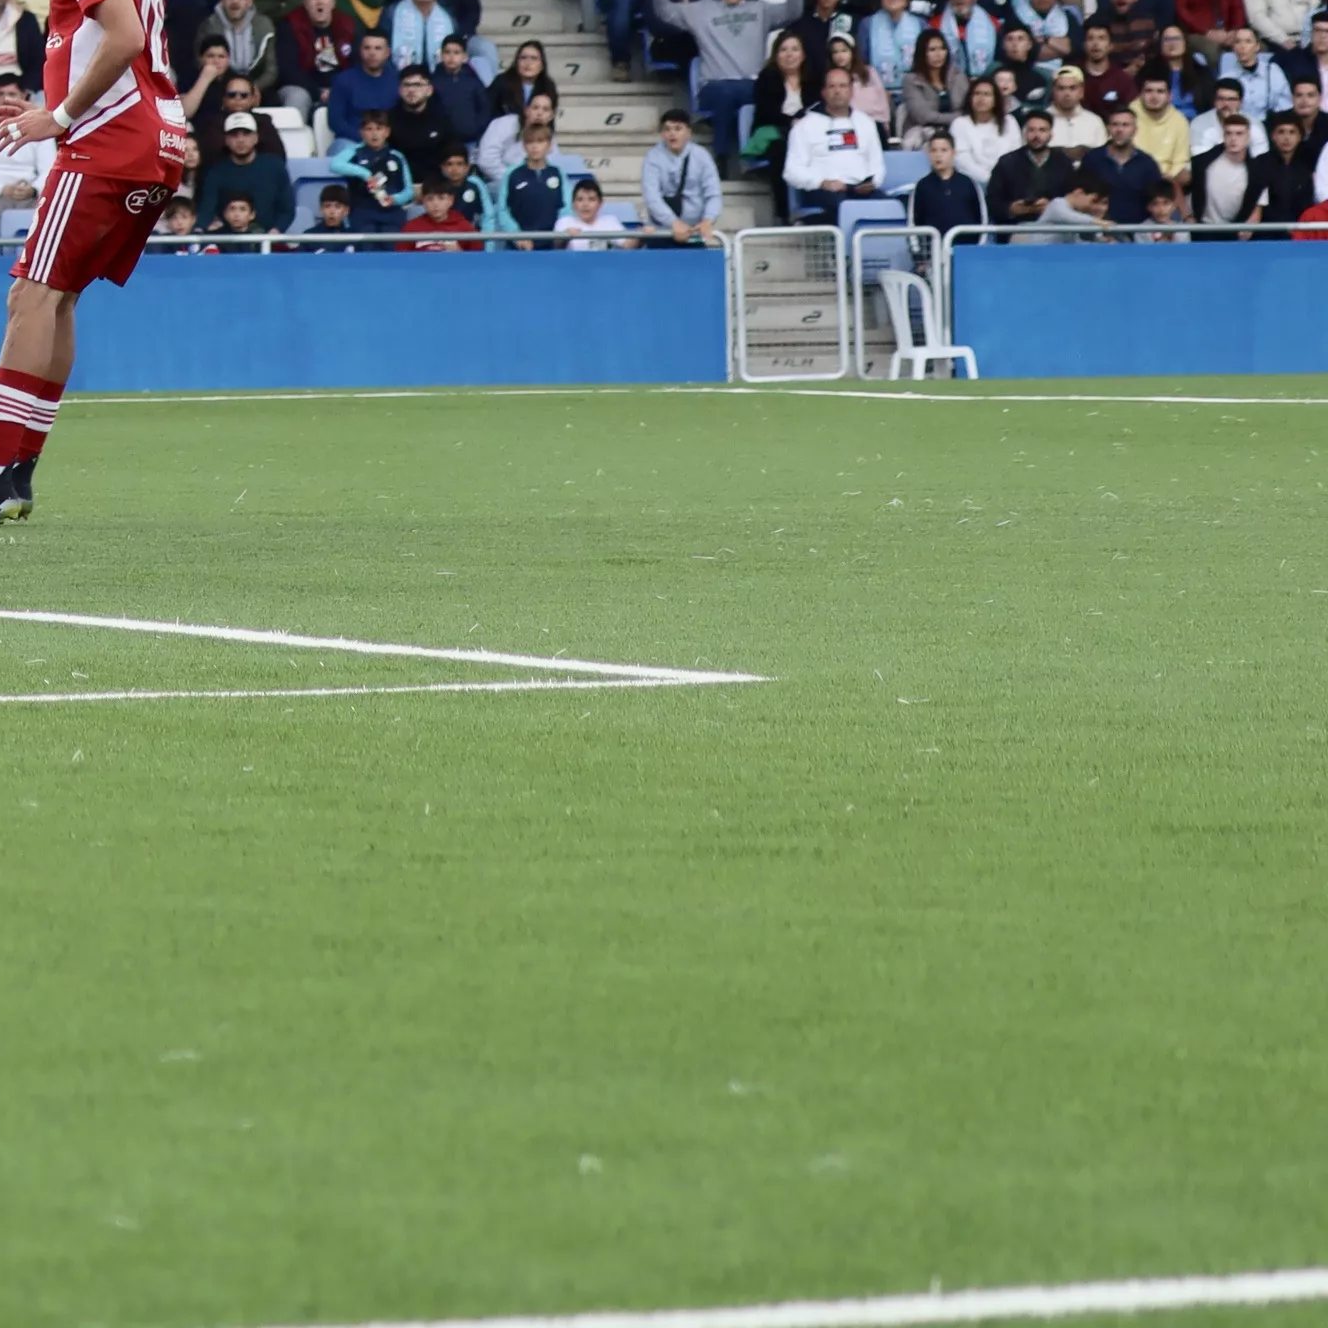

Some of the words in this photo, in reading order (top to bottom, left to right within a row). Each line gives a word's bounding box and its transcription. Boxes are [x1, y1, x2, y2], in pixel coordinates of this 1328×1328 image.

[511, 14, 532, 27] 8
[564, 62, 581, 76] 7
[603, 112, 625, 126] 6
